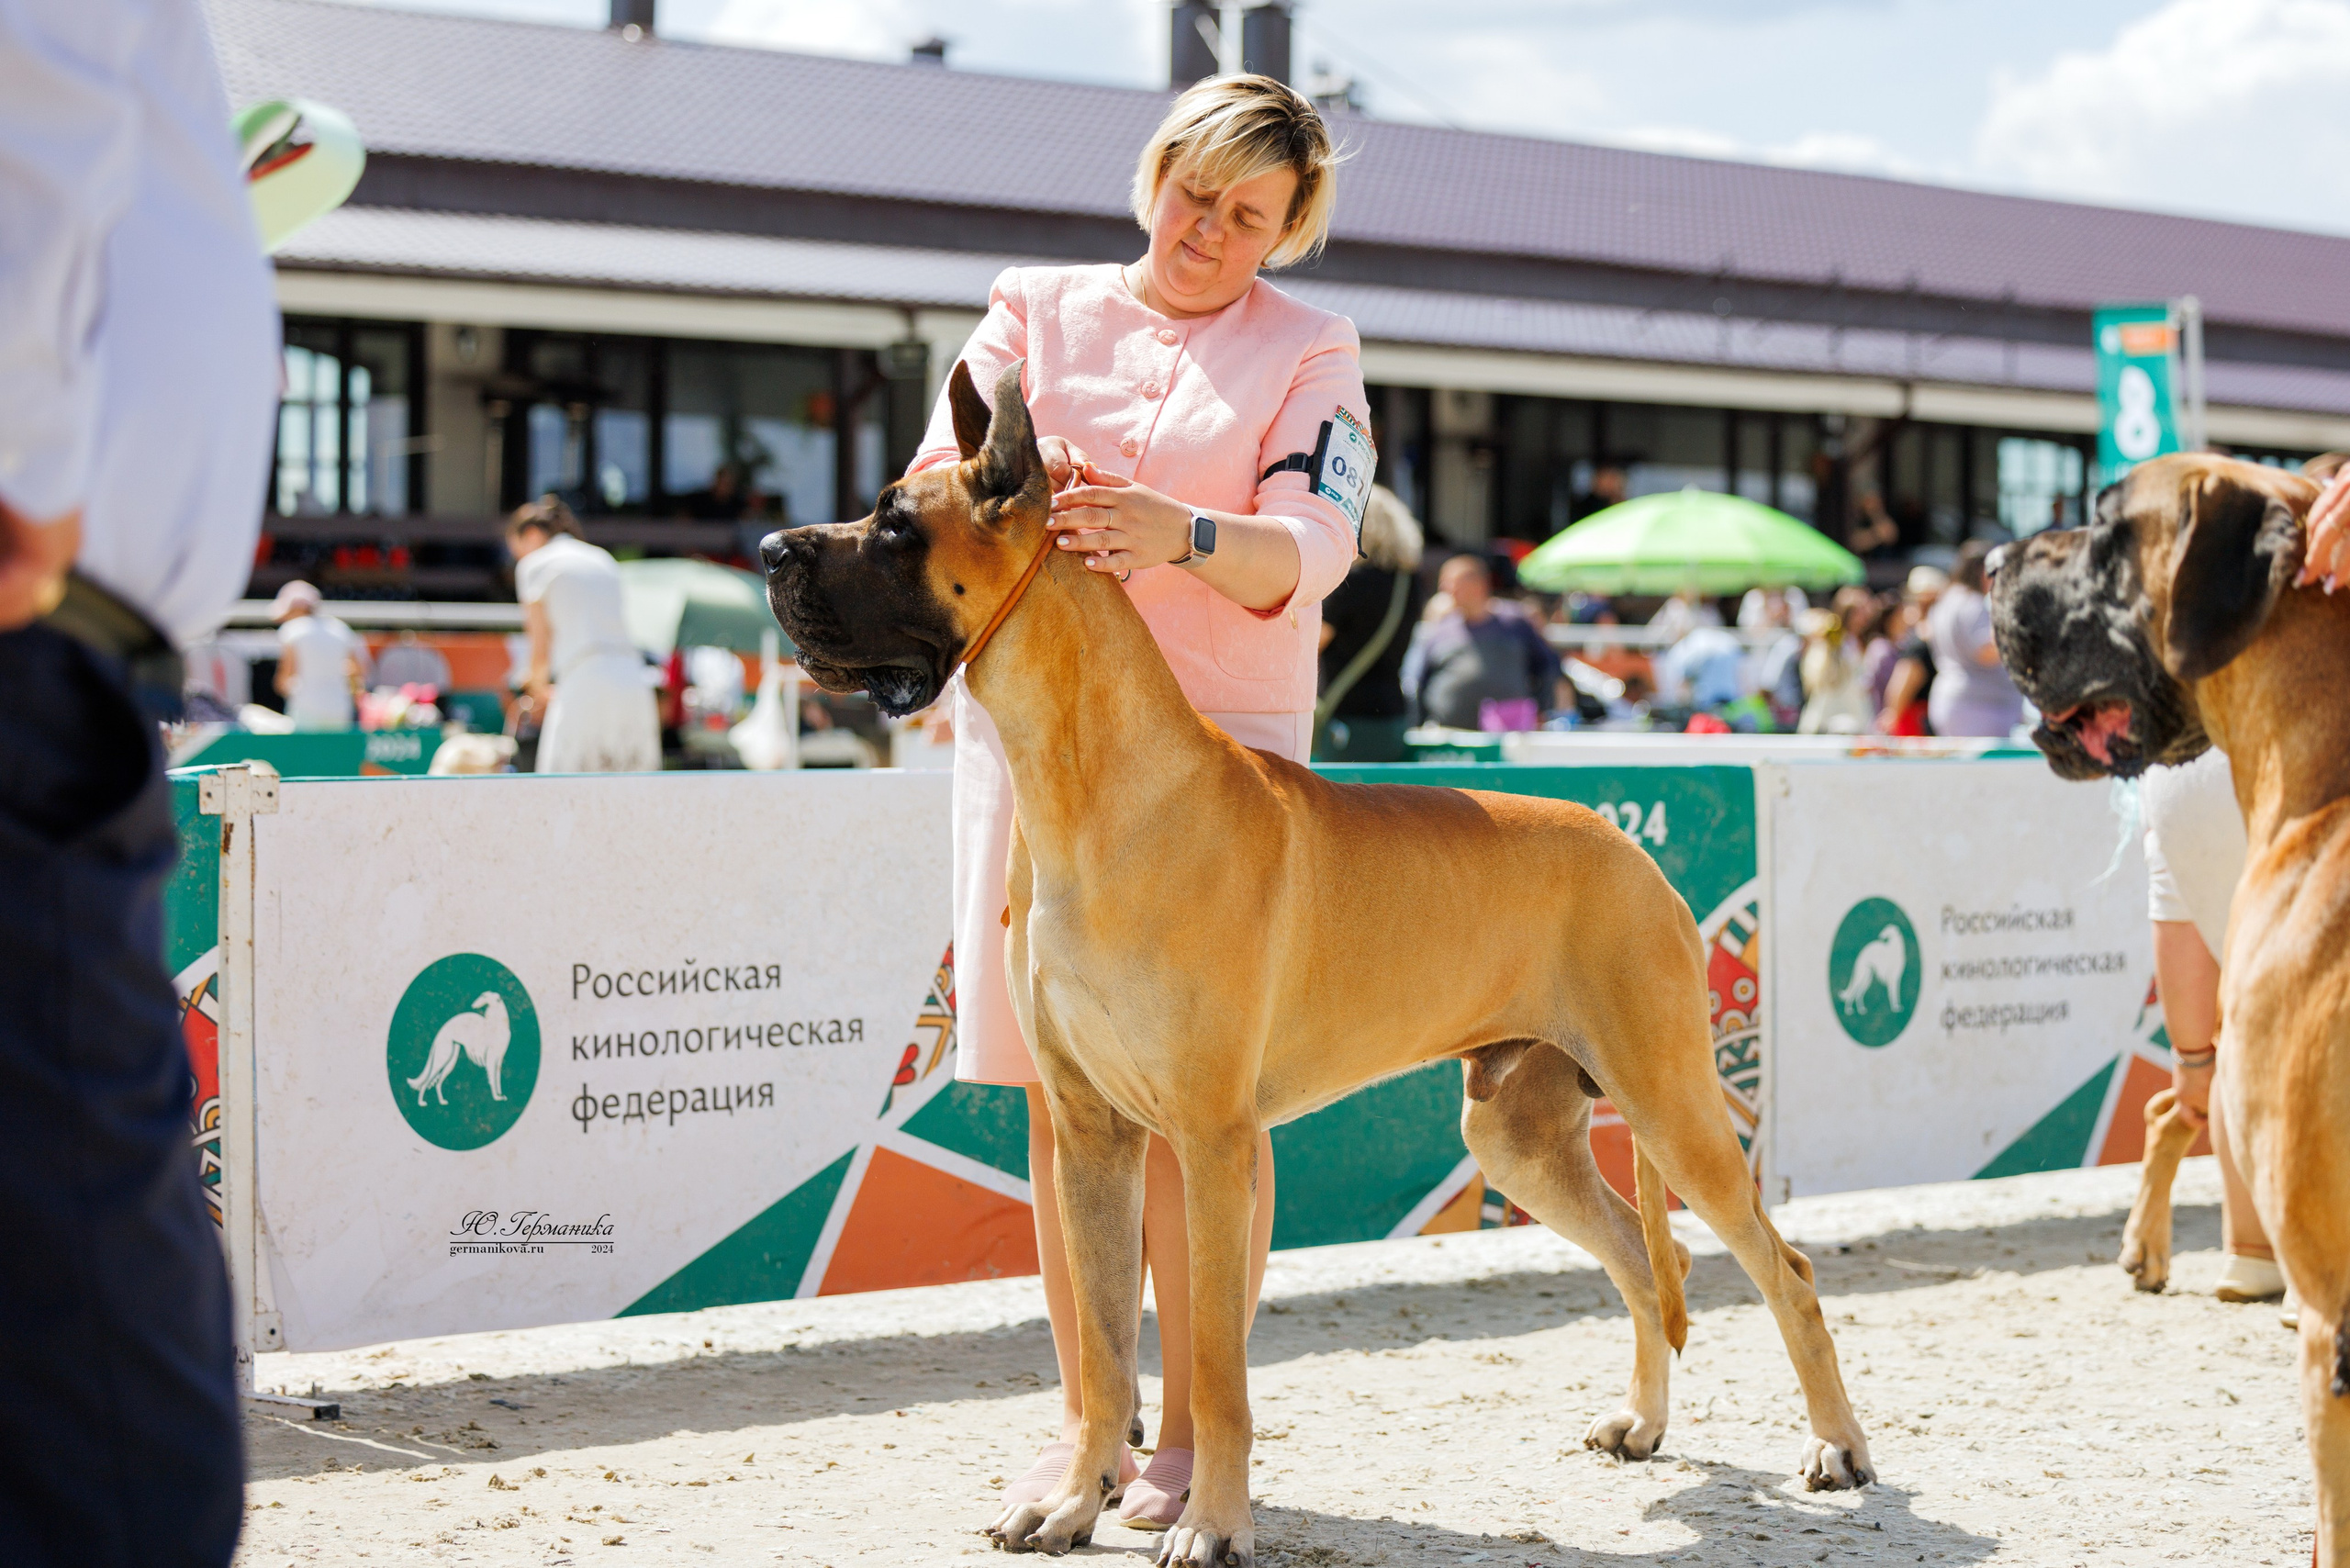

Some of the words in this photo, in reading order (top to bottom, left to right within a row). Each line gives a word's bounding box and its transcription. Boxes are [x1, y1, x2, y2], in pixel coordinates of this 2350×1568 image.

[2115, 365, 2160, 459] 8
[1581, 801, 1669, 846] 024
[1941, 903, 2075, 935] Российская
[572, 958, 782, 1000] Российская
[1941, 950, 2127, 980] кинологическая
[572, 1018, 864, 1060] кинологическая
[1941, 1000, 2069, 1036] федерация
[572, 1082, 774, 1133] федерация
